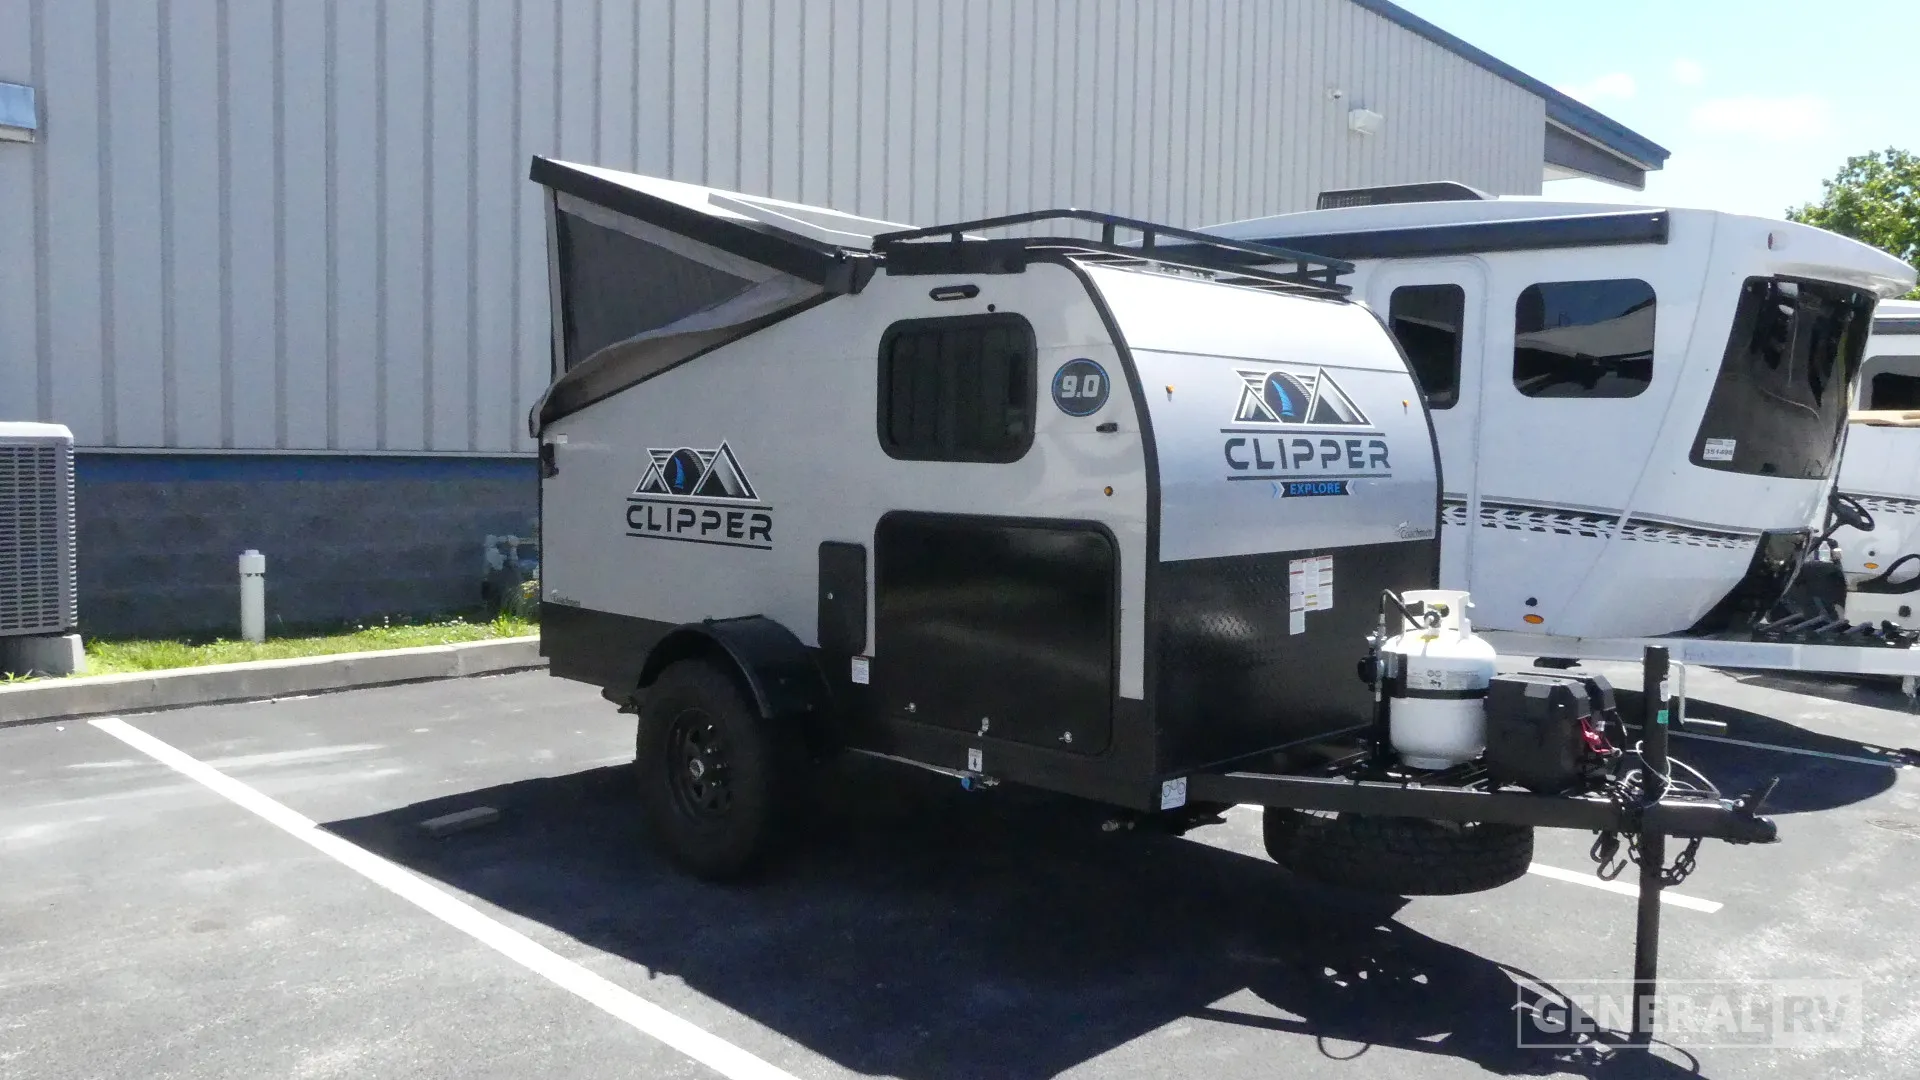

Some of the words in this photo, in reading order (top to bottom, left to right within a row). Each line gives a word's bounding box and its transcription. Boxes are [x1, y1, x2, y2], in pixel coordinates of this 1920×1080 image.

[1061, 374, 1100, 398] 9.0
[1224, 437, 1391, 470] CLIPPER
[1289, 482, 1342, 495] EXPLORE
[626, 504, 773, 542] CLIPPER
